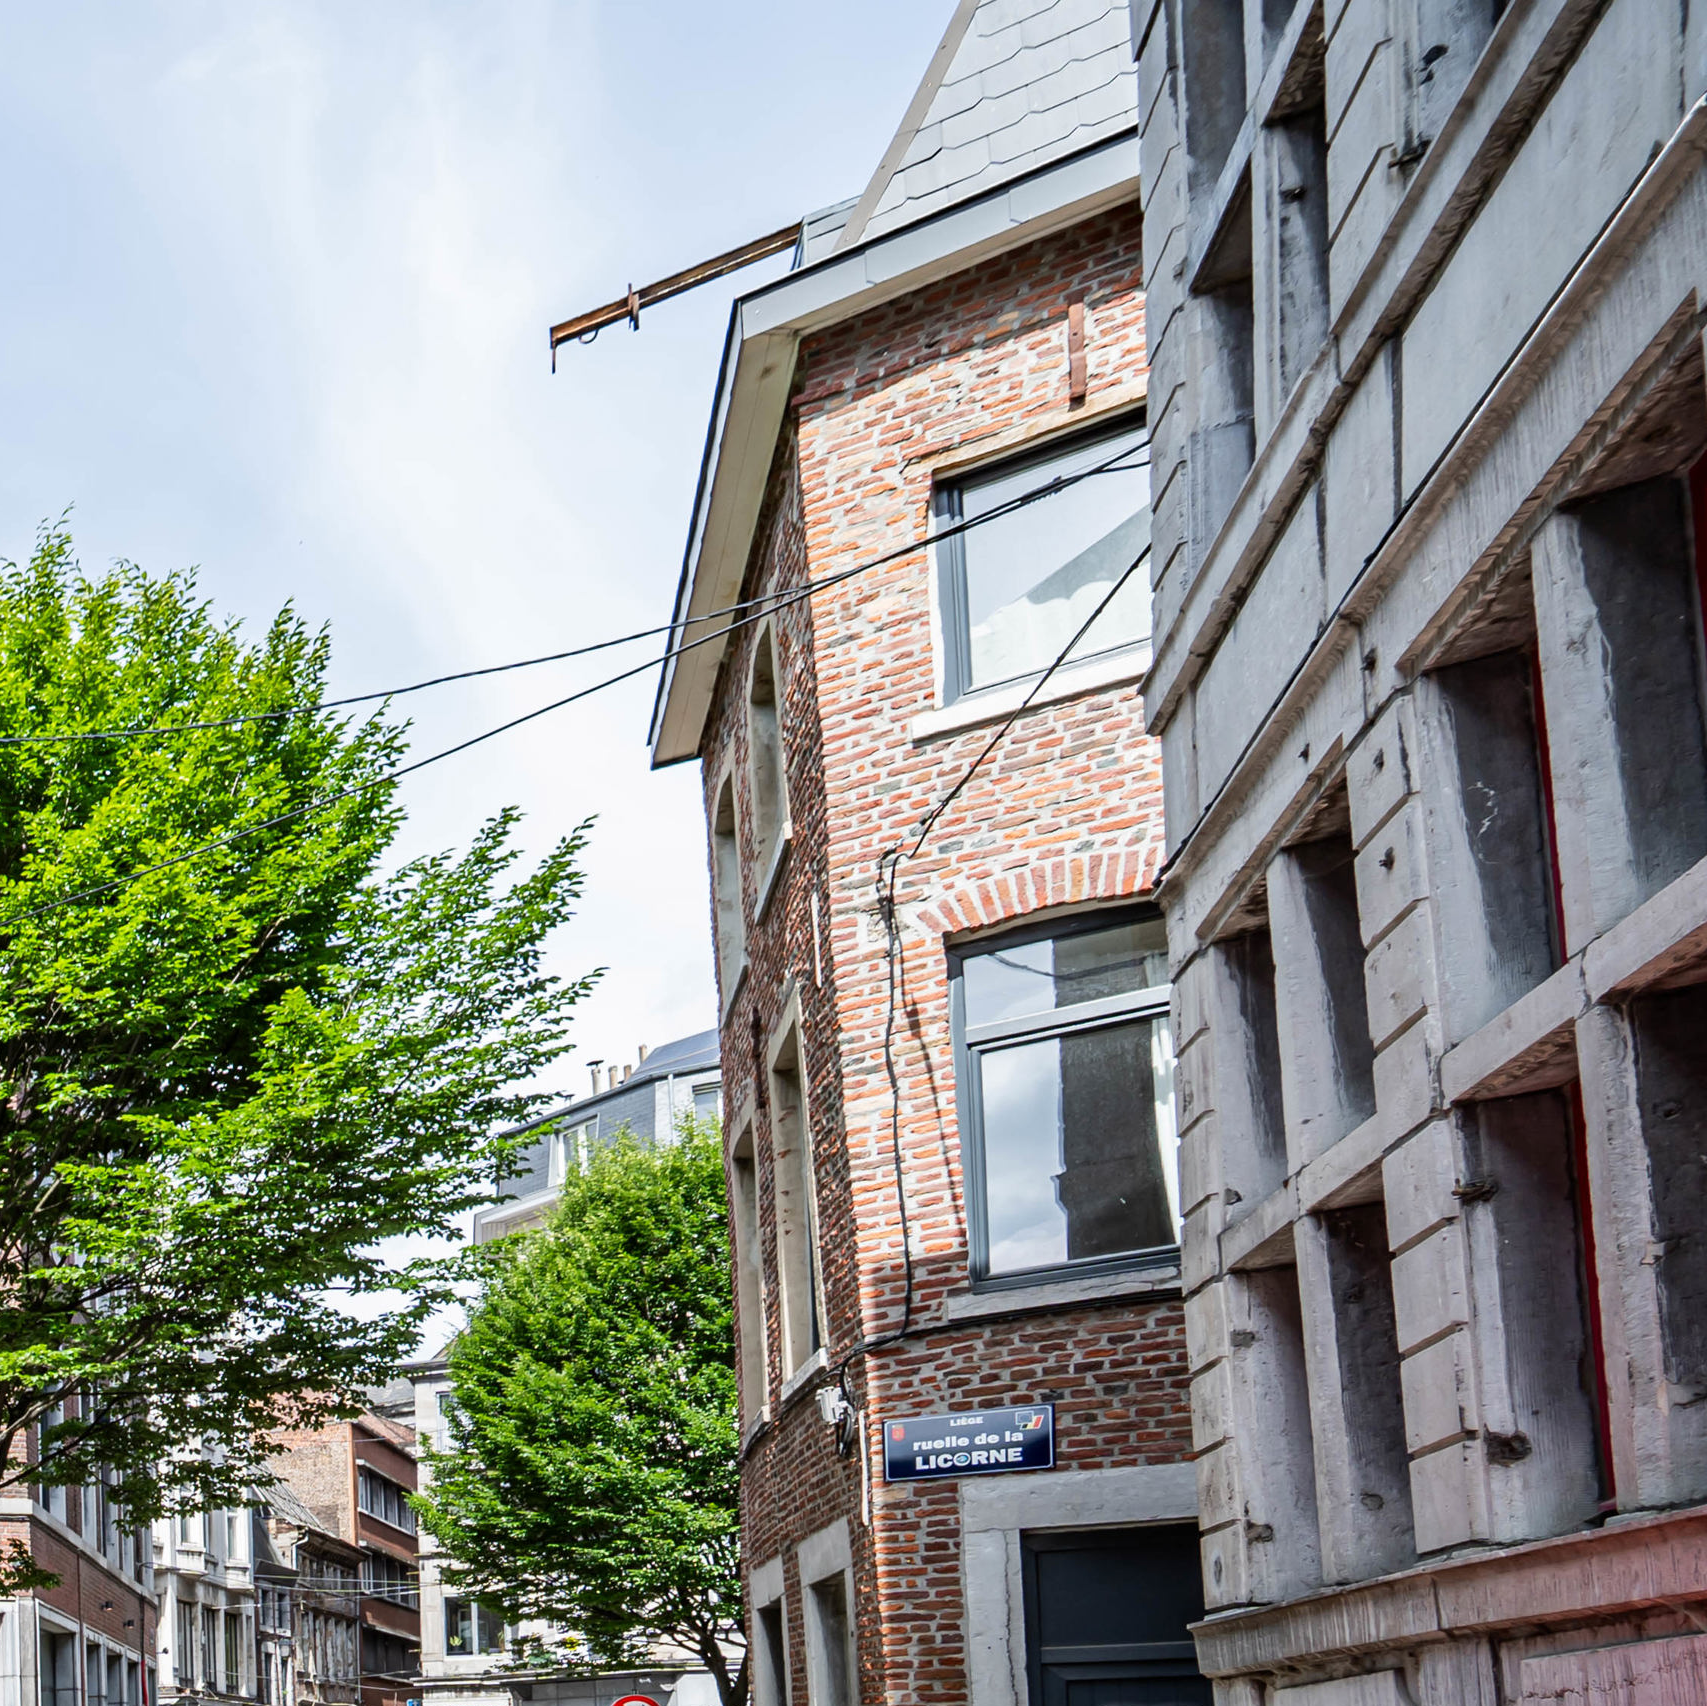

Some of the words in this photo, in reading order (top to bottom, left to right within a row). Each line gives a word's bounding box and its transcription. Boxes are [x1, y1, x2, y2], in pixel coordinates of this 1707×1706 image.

[912, 1436, 970, 1451] ruelle
[974, 1432, 1001, 1445] de
[1005, 1430, 1024, 1443] la
[915, 1447, 1023, 1471] LICORNE
